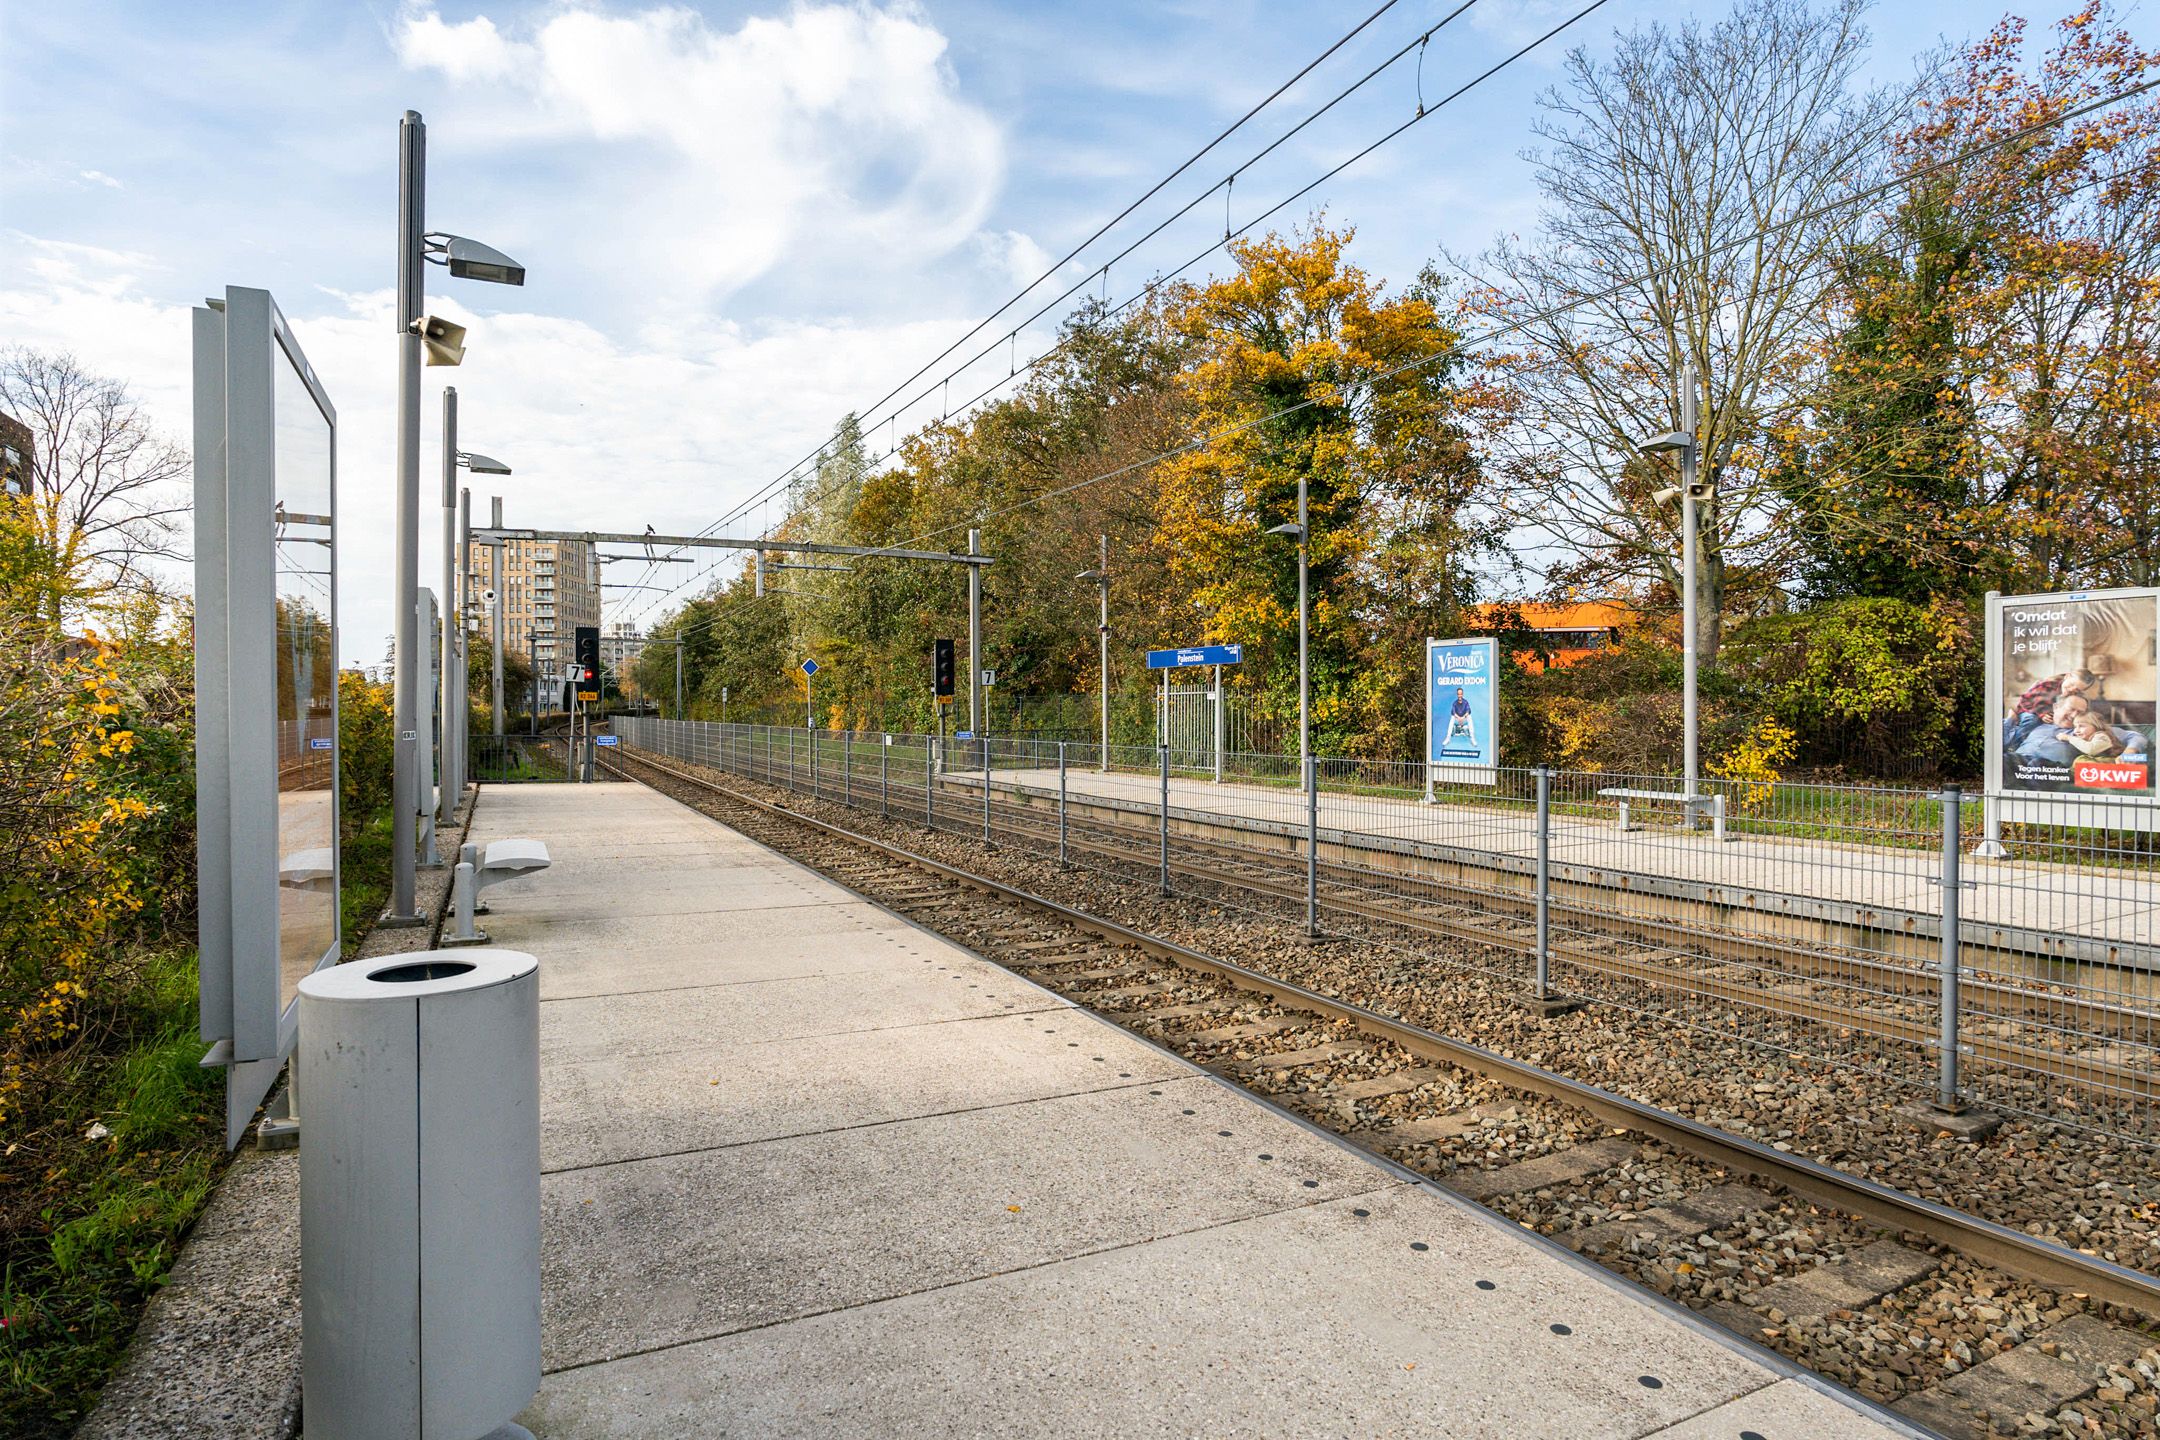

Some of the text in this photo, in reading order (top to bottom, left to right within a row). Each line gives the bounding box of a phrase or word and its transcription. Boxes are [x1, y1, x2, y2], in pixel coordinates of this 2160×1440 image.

[2014, 624, 2078, 637] ik wil dat
[2012, 641, 2026, 654] je
[571, 666, 580, 680] 7
[985, 672, 992, 683] 7
[1437, 676, 1463, 686] GERARD
[2018, 765, 2070, 774] Tegen kanker
[2015, 772, 2033, 780] Voor
[2048, 773, 2070, 781] leven
[2100, 769, 2142, 783] KWF
